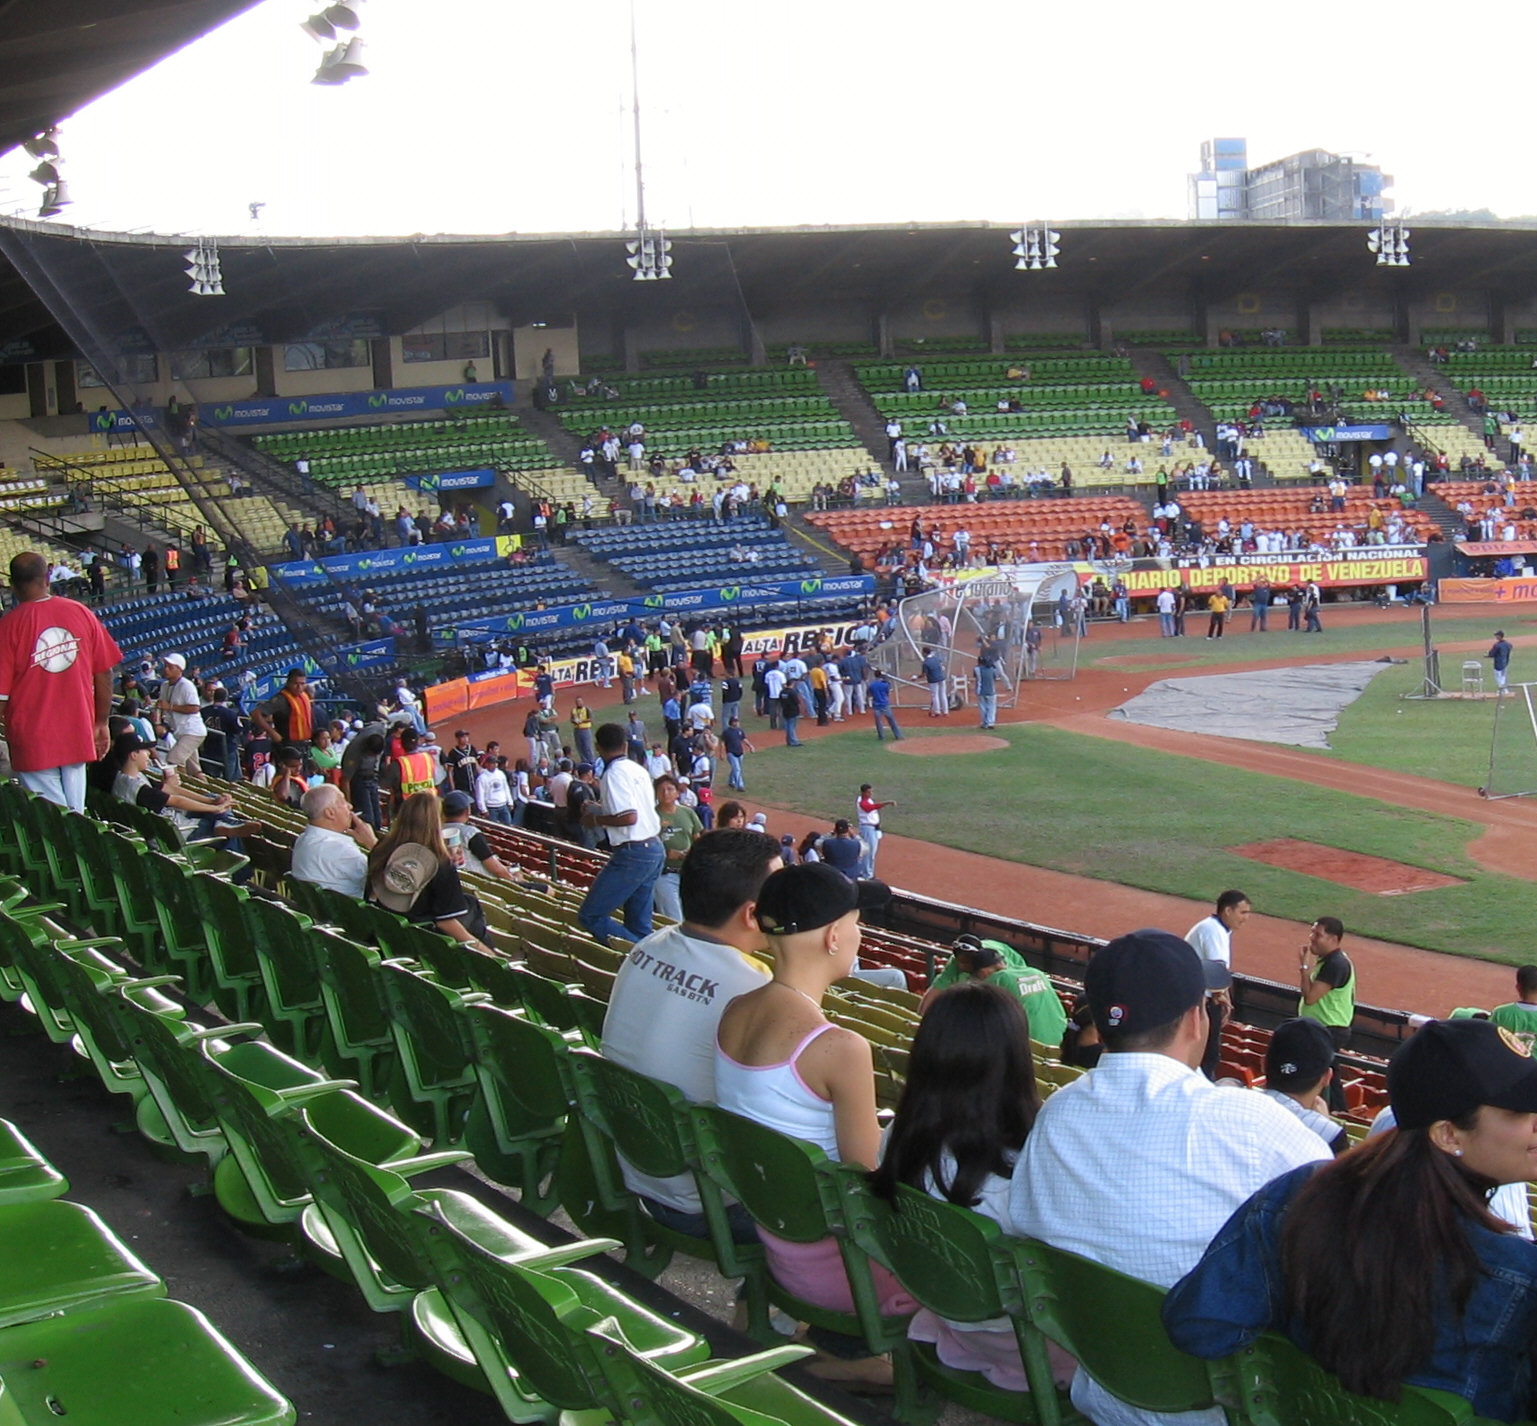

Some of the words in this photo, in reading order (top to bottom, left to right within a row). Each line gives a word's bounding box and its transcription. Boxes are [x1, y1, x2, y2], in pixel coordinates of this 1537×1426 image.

[1336, 429, 1373, 440] movistar
[440, 474, 480, 487] movistar
[1216, 557, 1230, 566] EN
[1346, 548, 1422, 562] NACIONAL
[1117, 570, 1181, 591] DIARIO
[1191, 565, 1291, 588] DEPORTIVO
[1299, 562, 1323, 582] DE
[1328, 558, 1424, 581] VENEZUELA
[823, 579, 865, 591] movistar
[665, 594, 703, 608] movistar
[592, 603, 629, 617] movistar
[525, 614, 560, 627] movistar
[33, 640, 77, 663] REGIONAL
[654, 960, 720, 998] TRACK
[1018, 979, 1047, 998] Draft
